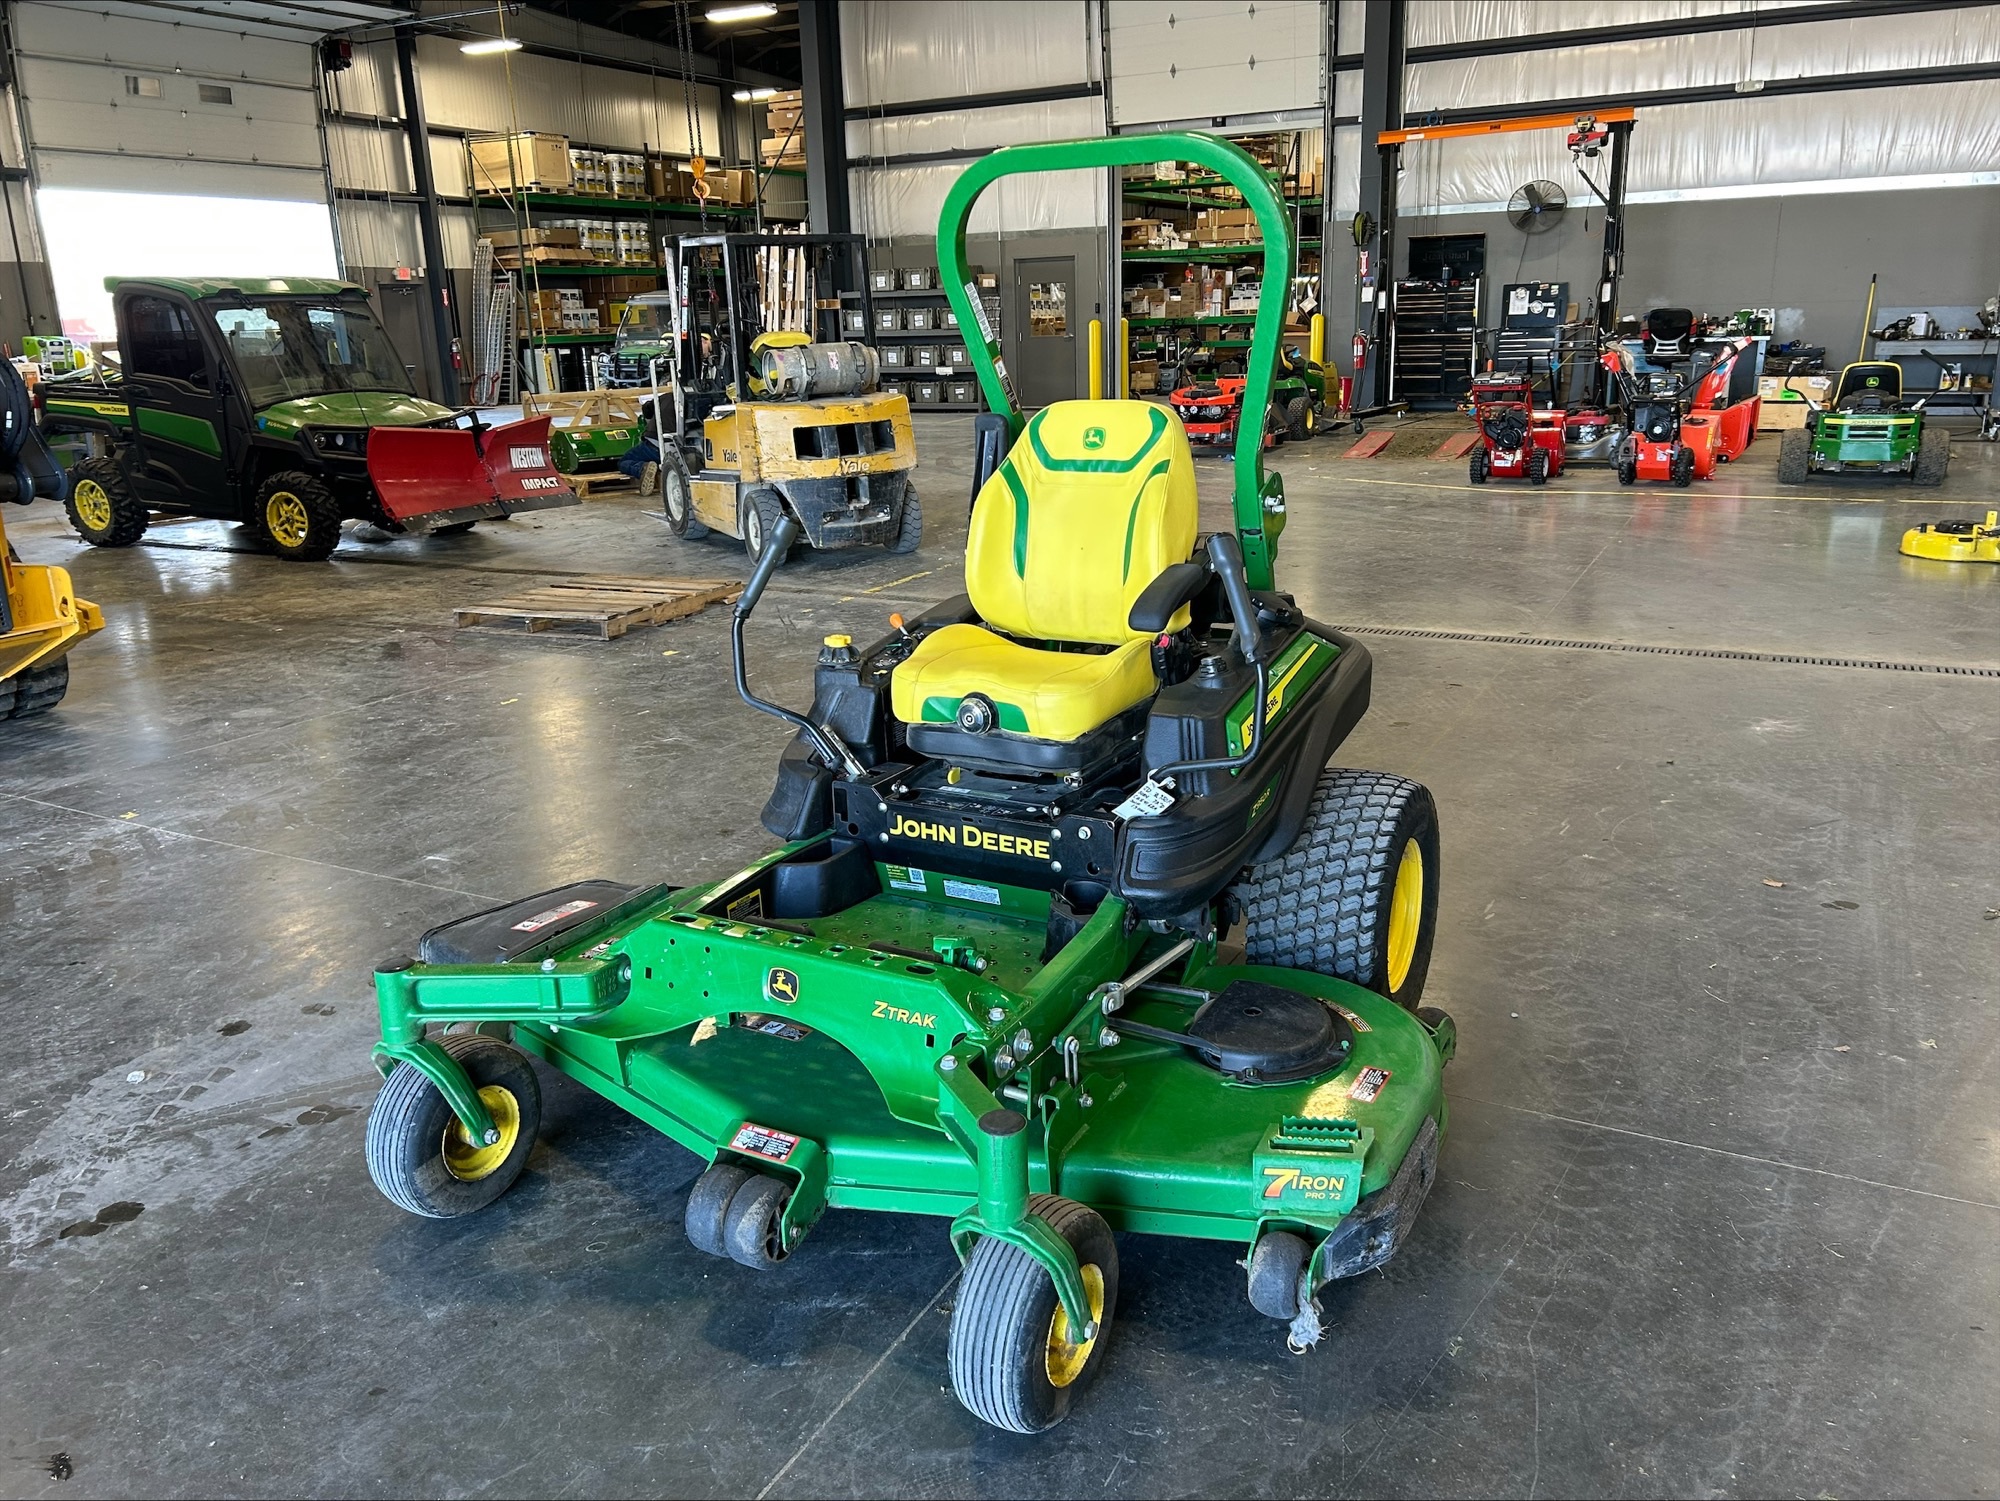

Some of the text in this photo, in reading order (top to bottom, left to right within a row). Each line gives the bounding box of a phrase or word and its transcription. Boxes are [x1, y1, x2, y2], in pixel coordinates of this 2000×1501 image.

[510, 447, 546, 469] WESTERN
[722, 449, 738, 463] Yale
[841, 459, 870, 473] Yale
[521, 476, 559, 490] IMPACT
[889, 814, 1050, 859] JOHN DEERE
[871, 1000, 938, 1029] ZTRAK
[1304, 1192, 1341, 1200] PRO 72
